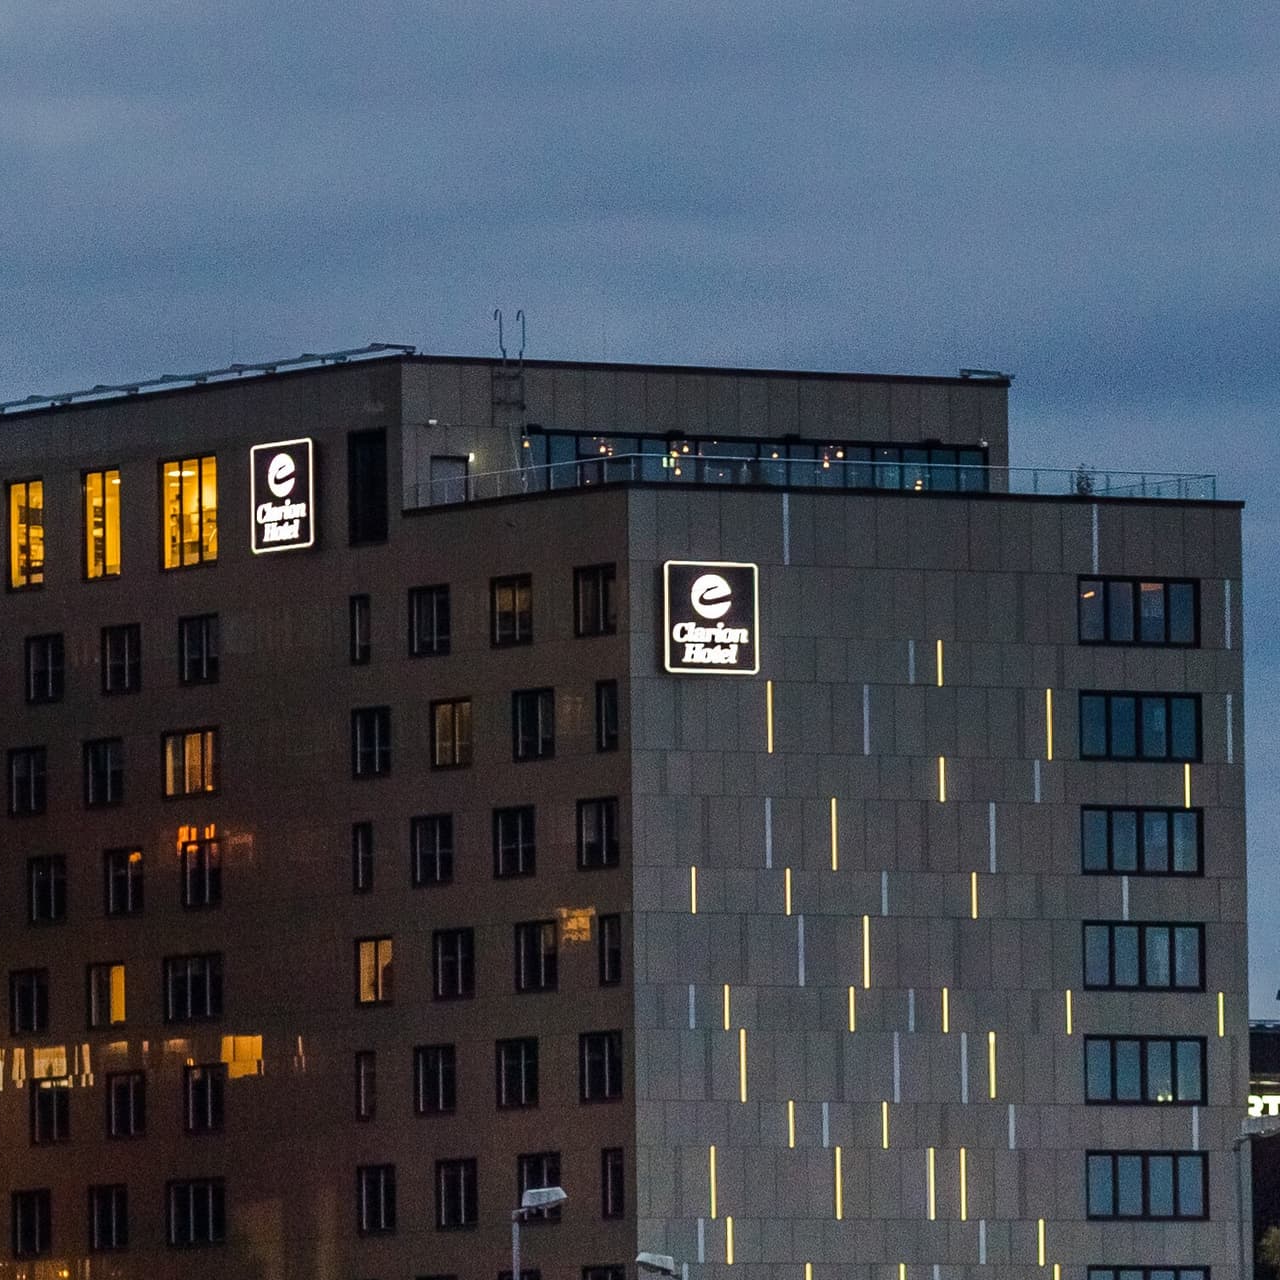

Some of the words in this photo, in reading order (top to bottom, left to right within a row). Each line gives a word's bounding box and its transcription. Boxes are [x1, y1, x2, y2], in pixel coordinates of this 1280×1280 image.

[256, 498, 307, 524] Clarion
[263, 518, 300, 543] Hotel
[672, 621, 749, 644] Clarion
[681, 642, 739, 664] Hotel
